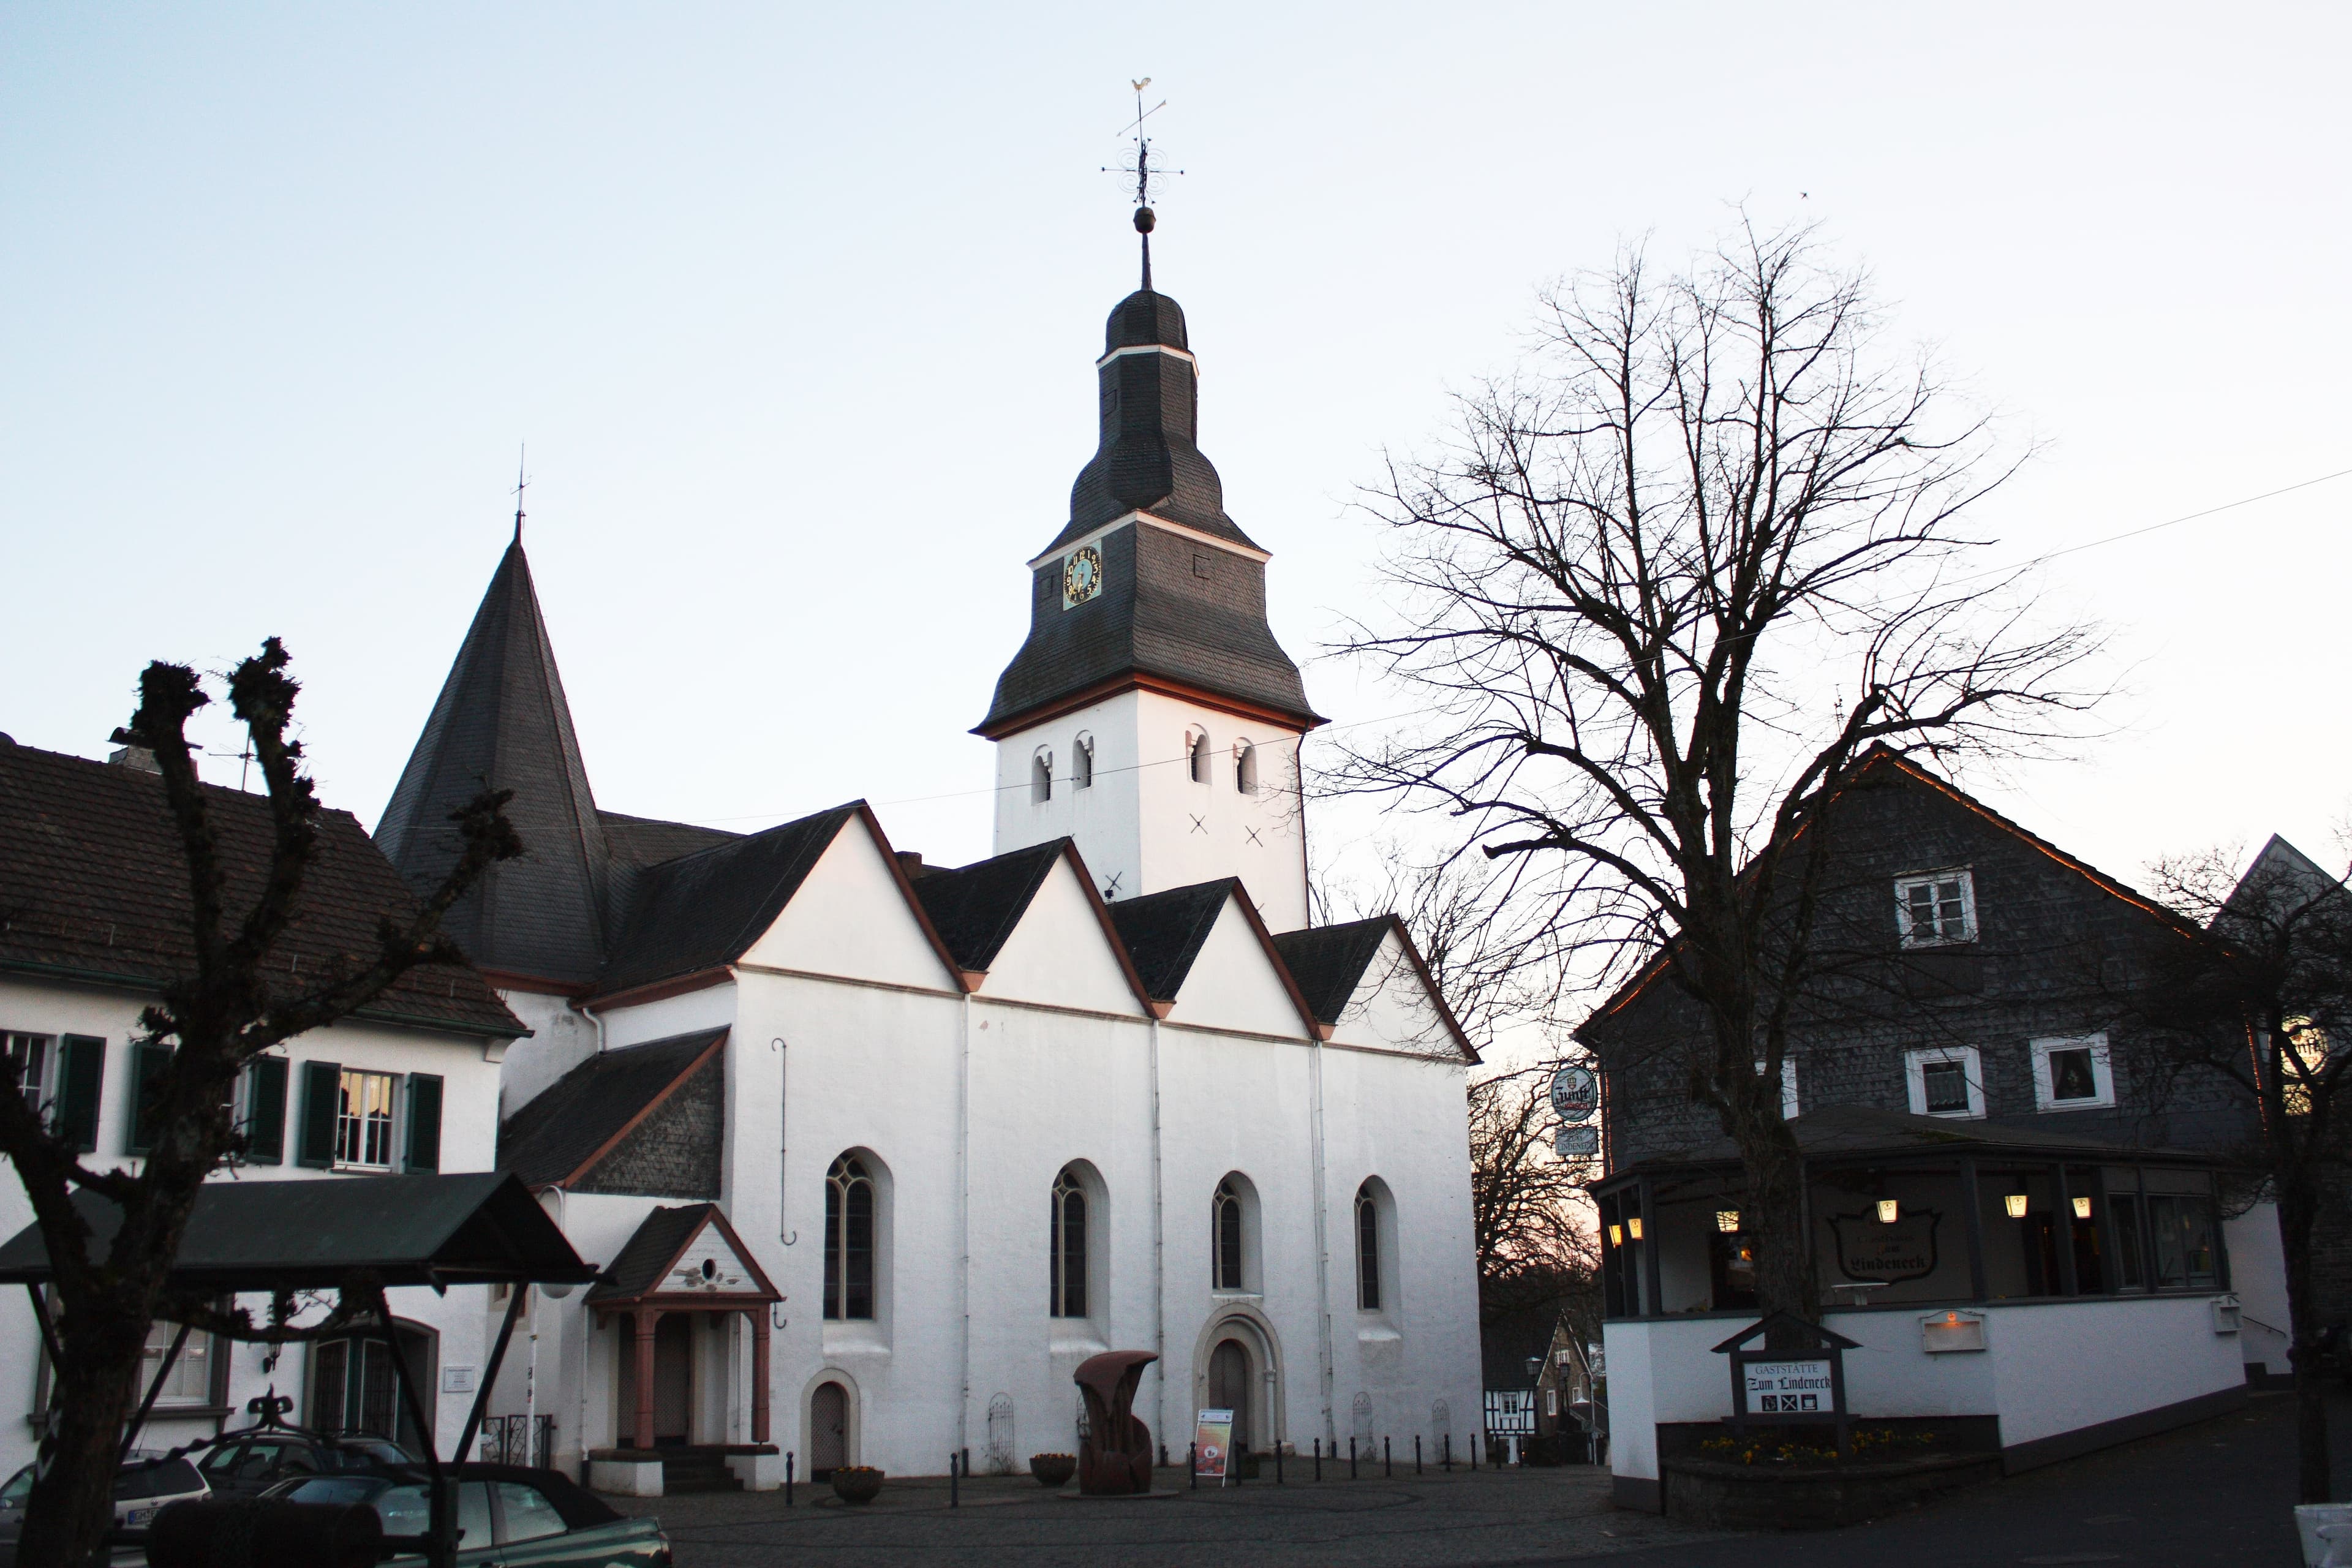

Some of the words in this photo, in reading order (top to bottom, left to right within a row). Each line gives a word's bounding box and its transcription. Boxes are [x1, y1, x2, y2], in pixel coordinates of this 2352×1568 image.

[1080, 550, 1085, 560] 12
[1087, 549, 1090, 559] 1
[1092, 554, 1096, 564] 2
[1073, 556, 1077, 565] 11
[1068, 565, 1073, 575] 10
[1093, 564, 1098, 573] 3
[1066, 576, 1071, 586] 9
[1091, 575, 1096, 584] 4
[1068, 586, 1072, 595] 8
[1087, 584, 1091, 594] 5
[1073, 591, 1077, 600] 7
[1080, 590, 1084, 600] 6
[1851, 1254, 1926, 1272] Lindeneck
[1747, 1377, 1773, 1390] Zum
[1777, 1376, 1831, 1390] Lindeneck
